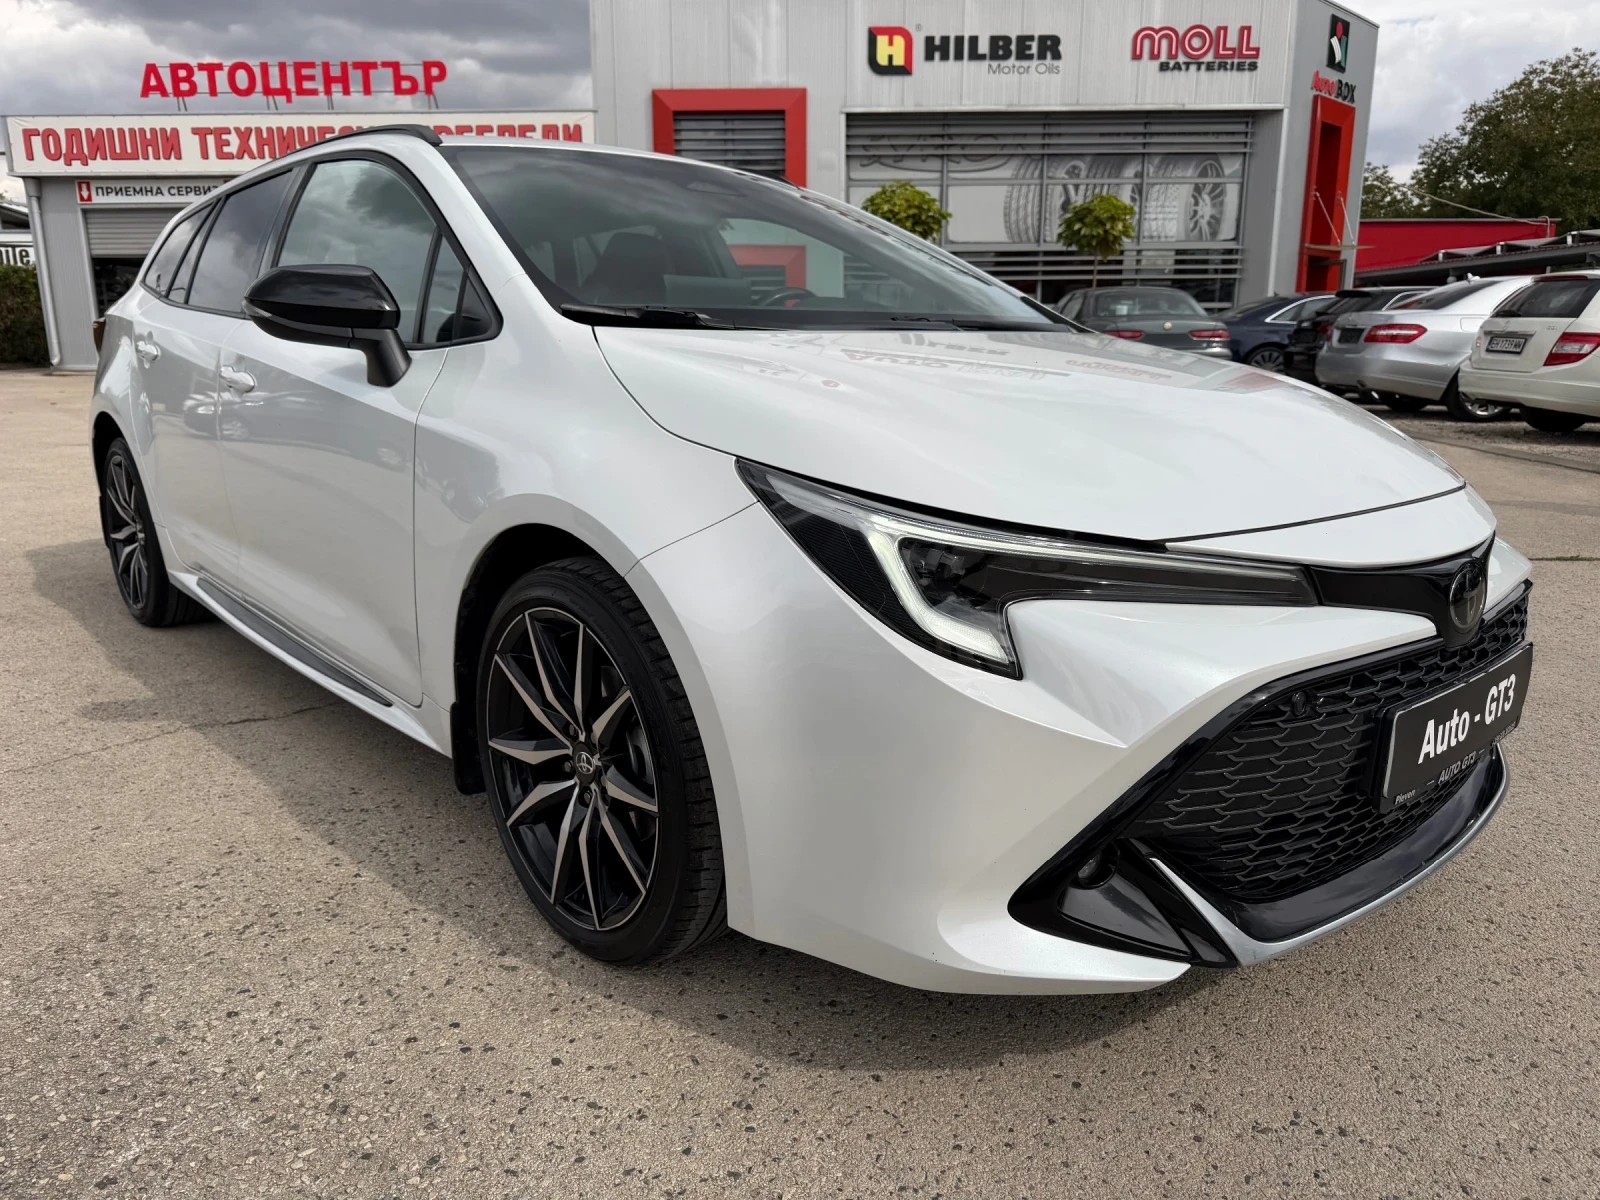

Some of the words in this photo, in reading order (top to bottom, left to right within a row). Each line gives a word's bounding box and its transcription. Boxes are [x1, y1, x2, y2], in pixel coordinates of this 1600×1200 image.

[924, 34, 1062, 62] HILBER
[987, 62, 1032, 75] Motor
[1035, 62, 1061, 75] Oils
[1158, 61, 1259, 72] BATTERIES
[139, 60, 447, 104] АВТОЦЕНТЪР
[1335, 78, 1356, 104] BOX
[21, 127, 183, 167] ГОДИШНИ
[191, 125, 364, 161] ТЕХНИЧ
[95, 186, 164, 197] ПРИЕМНА
[1417, 708, 1470, 765] Auto
[1484, 673, 1516, 725] GT3
[1437, 762, 1461, 785] AUTO
[1461, 750, 1477, 770] GT3
